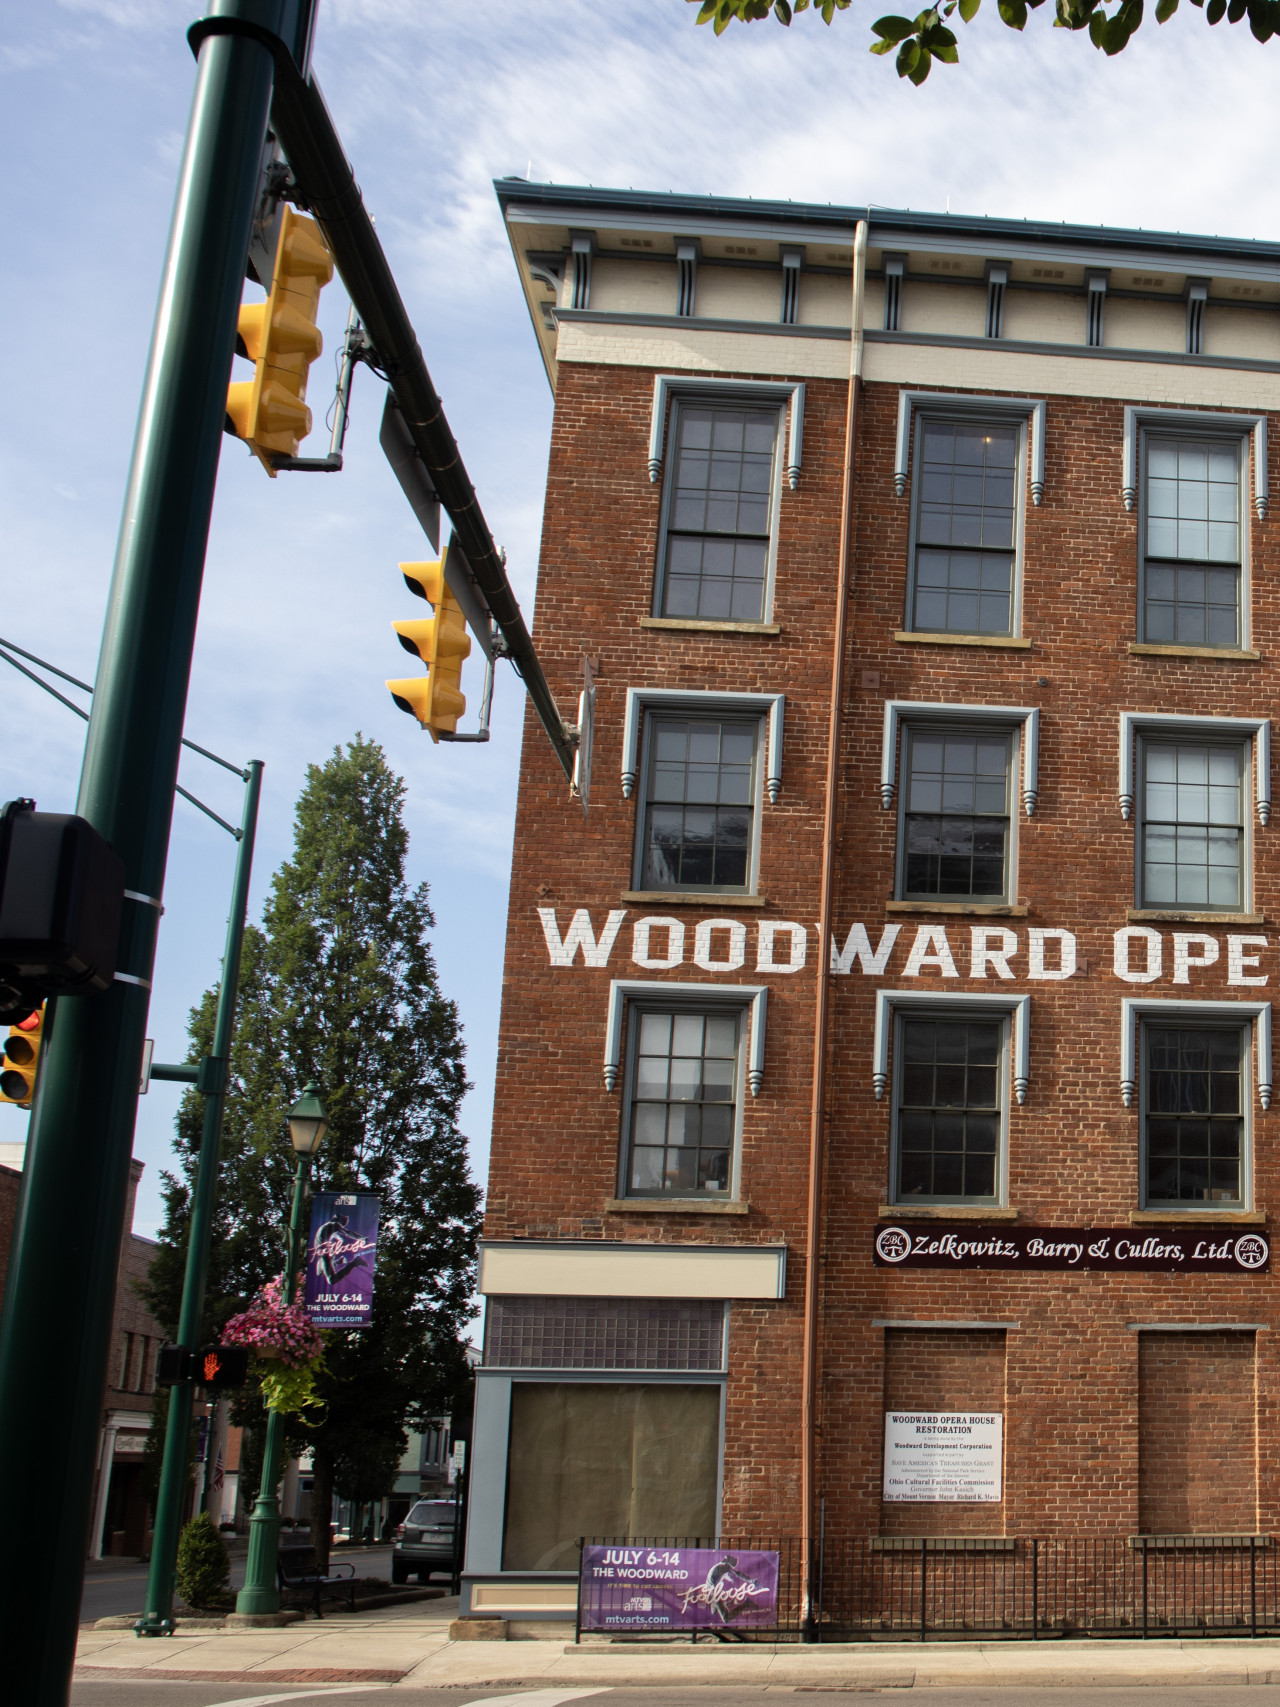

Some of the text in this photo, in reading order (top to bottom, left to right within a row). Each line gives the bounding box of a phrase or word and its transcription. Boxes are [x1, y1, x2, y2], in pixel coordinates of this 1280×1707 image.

[537, 907, 1077, 980] WOODWARD
[881, 1235, 905, 1245] ZBC
[911, 1234, 1233, 1263] Zelkowitz, Barry & Cullers, Ltd.
[1240, 1241, 1262, 1253] ZBC
[315, 1294, 362, 1303] JULY 6-14
[892, 1415, 996, 1425] WOODWARD OPERA HOUSE
[915, 1426, 972, 1434] RESTORATION
[959, 1443, 992, 1451] Corporation
[938, 1493, 955, 1501] Mayor
[602, 1550, 680, 1566] JULY 6-14
[592, 1567, 689, 1580] THE WOODWARD
[676, 1581, 770, 1614] Footloose
[605, 1615, 670, 1624] mtvarts.com
